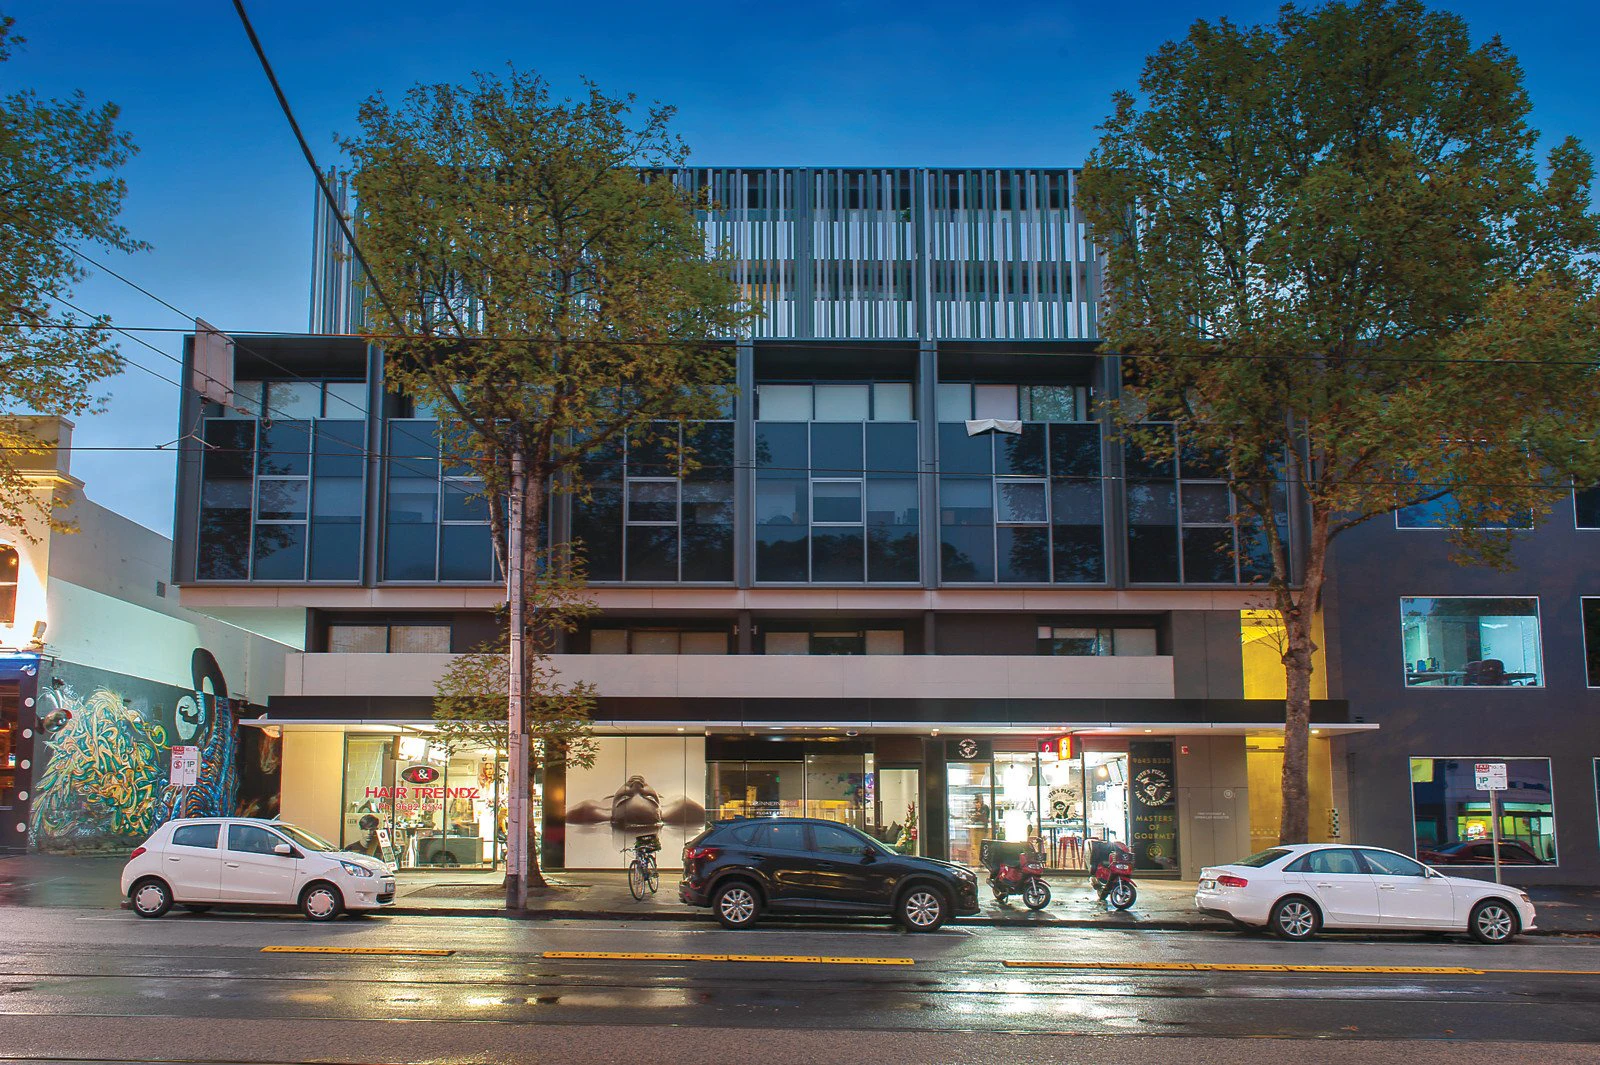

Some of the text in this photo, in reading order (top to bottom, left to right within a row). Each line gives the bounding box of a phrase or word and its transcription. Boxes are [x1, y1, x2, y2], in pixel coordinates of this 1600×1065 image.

[365, 787, 480, 799] HAIR TRENDZ
[395, 803, 420, 811] 9682
